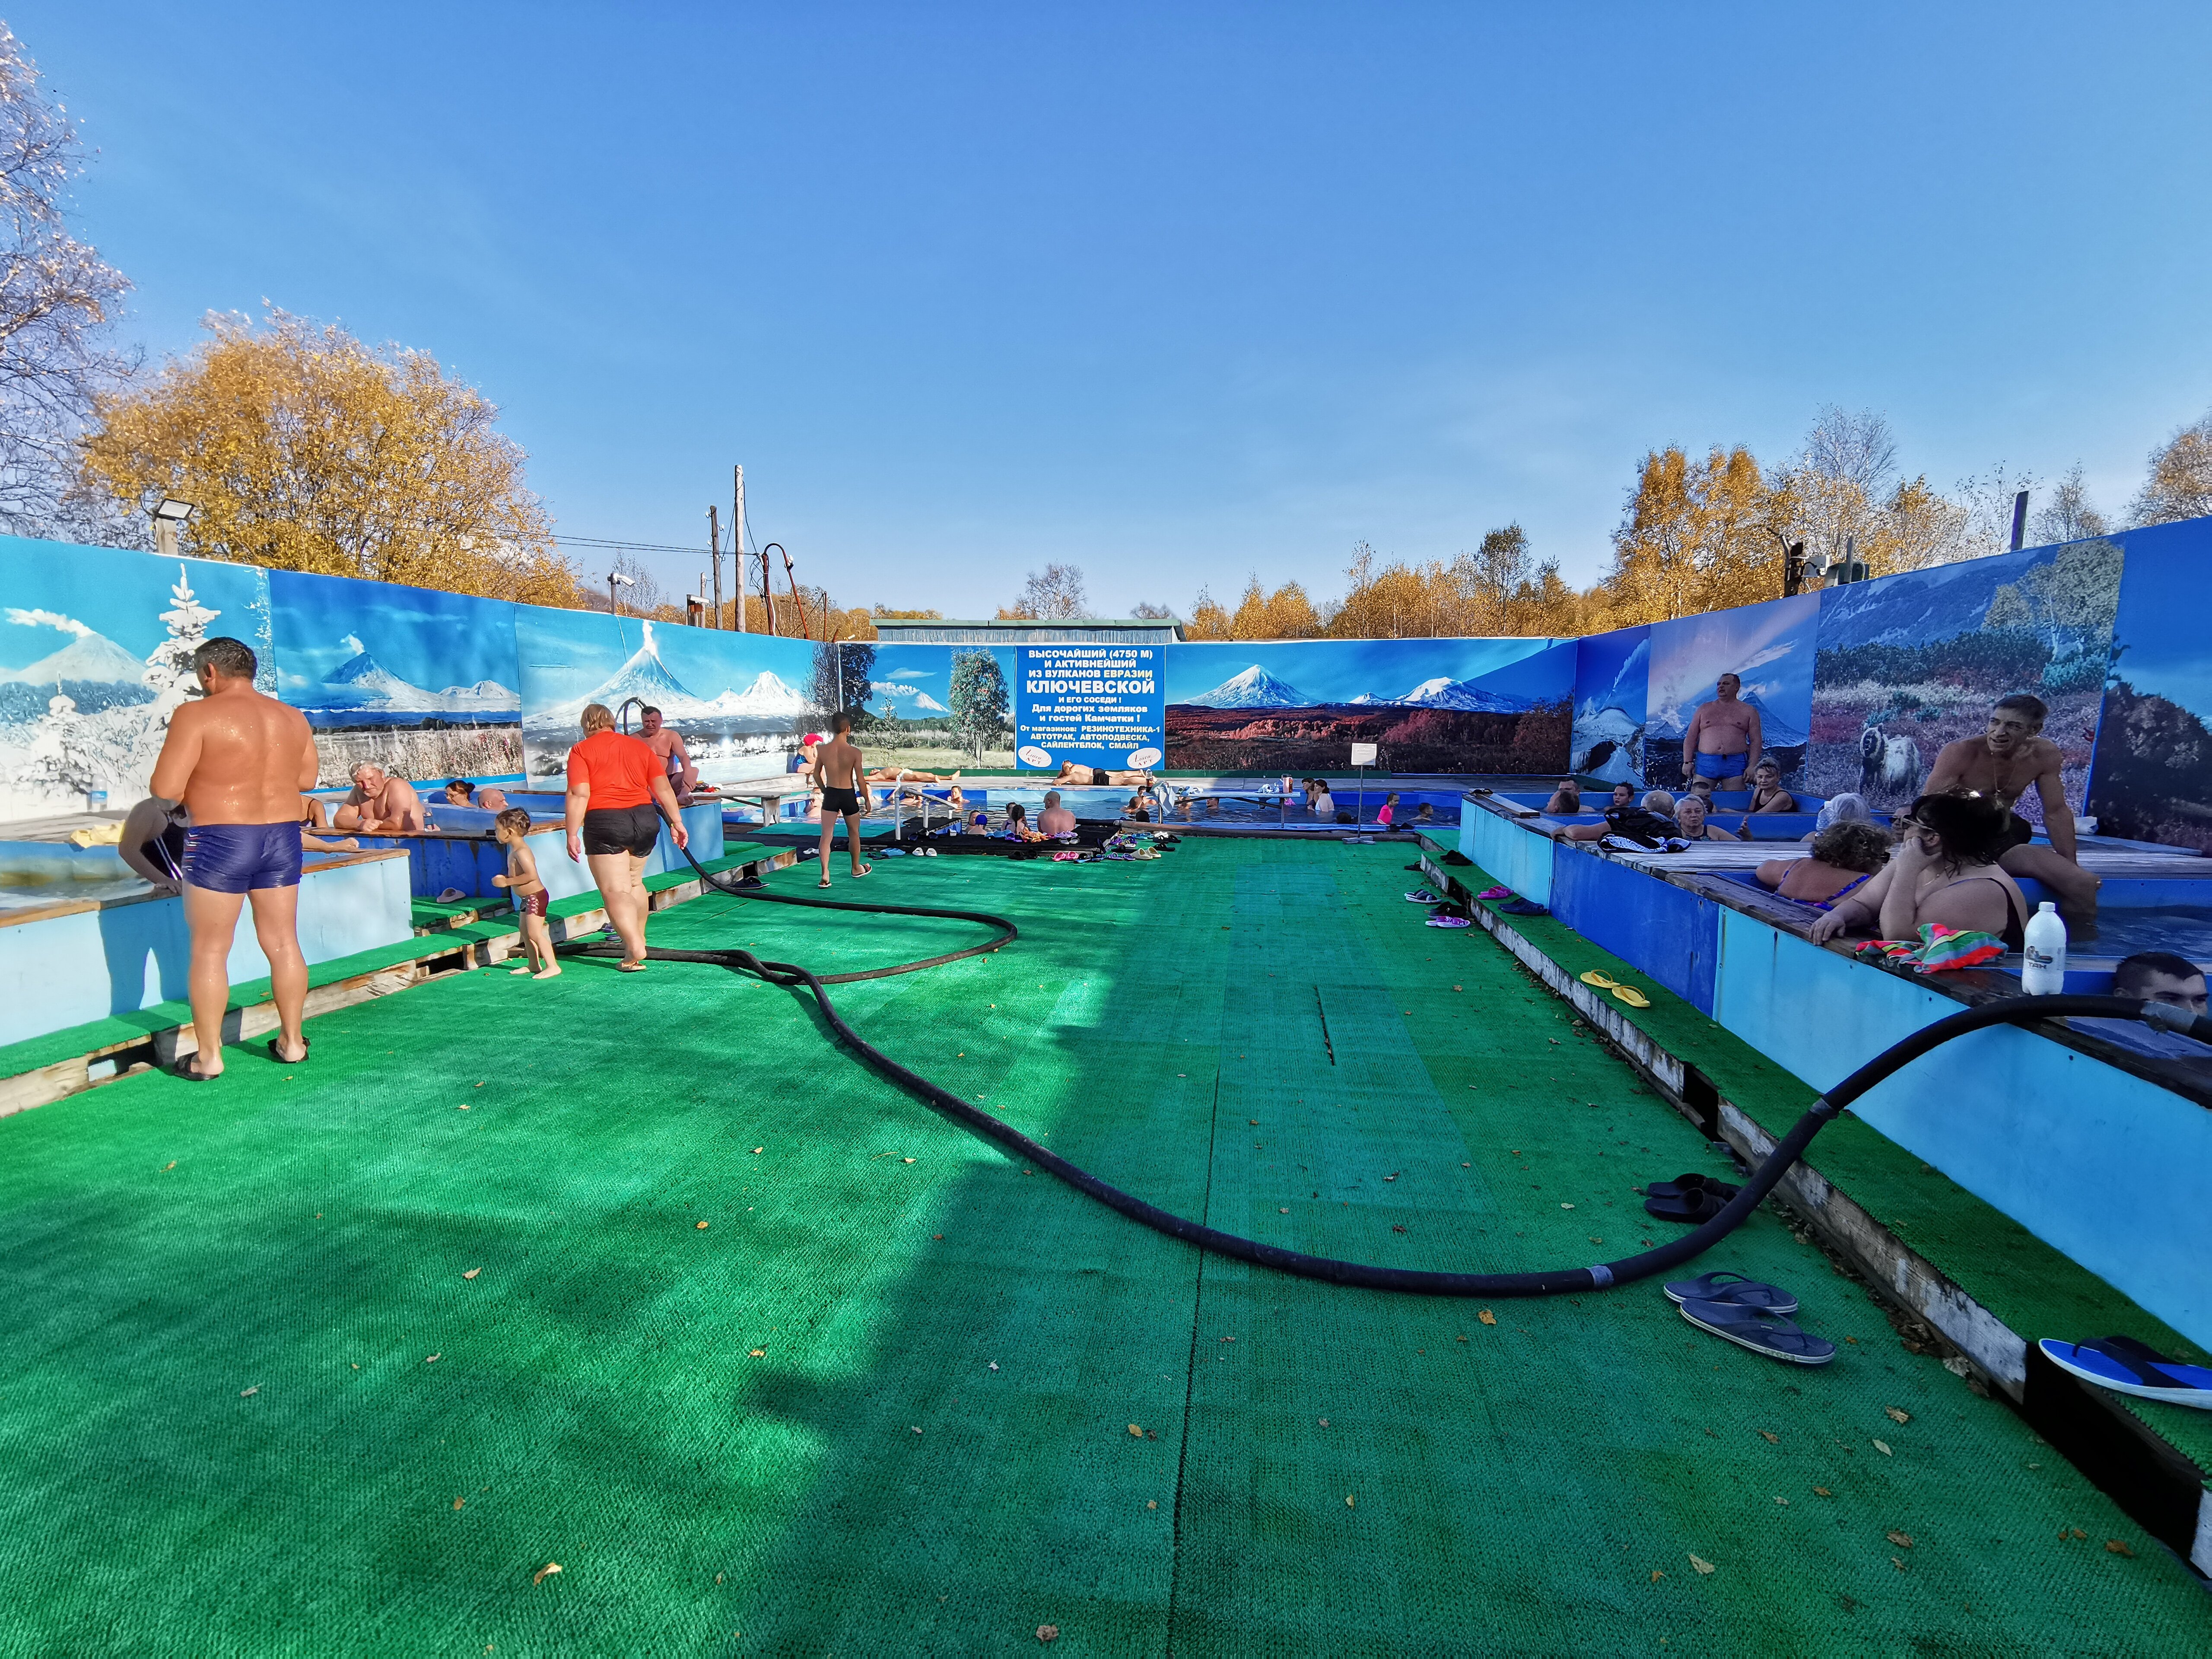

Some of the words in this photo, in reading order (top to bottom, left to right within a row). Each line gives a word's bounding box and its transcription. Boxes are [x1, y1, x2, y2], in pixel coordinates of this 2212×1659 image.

[1028, 648, 1106, 658] ВЫСОЧАЙШИЙ
[1109, 649, 1138, 660] (4750
[1140, 649, 1153, 660] М)
[1044, 659, 1052, 668] И
[1054, 658, 1137, 668] АКТИВНЕЙШИЙ
[1028, 669, 1042, 678] ИЗ
[1045, 669, 1101, 678] ВУЛКАНОВ
[1103, 669, 1153, 678] ЕВРАЗИИ
[1026, 678, 1155, 694] КЛЮЧЕВСКОЙ
[1032, 704, 1052, 713] Для
[1054, 706, 1095, 714] дорогих
[1049, 714, 1082, 722] гостей
[1084, 714, 1134, 722] Камчатки
[1137, 714, 1140, 722] !
[1030, 733, 1076, 741] АВТОТРАК,
[1080, 734, 1150, 742] АВТОПОДВЕСКА,
[1041, 741, 1105, 750] САЙЛЕНТБЛОК,
